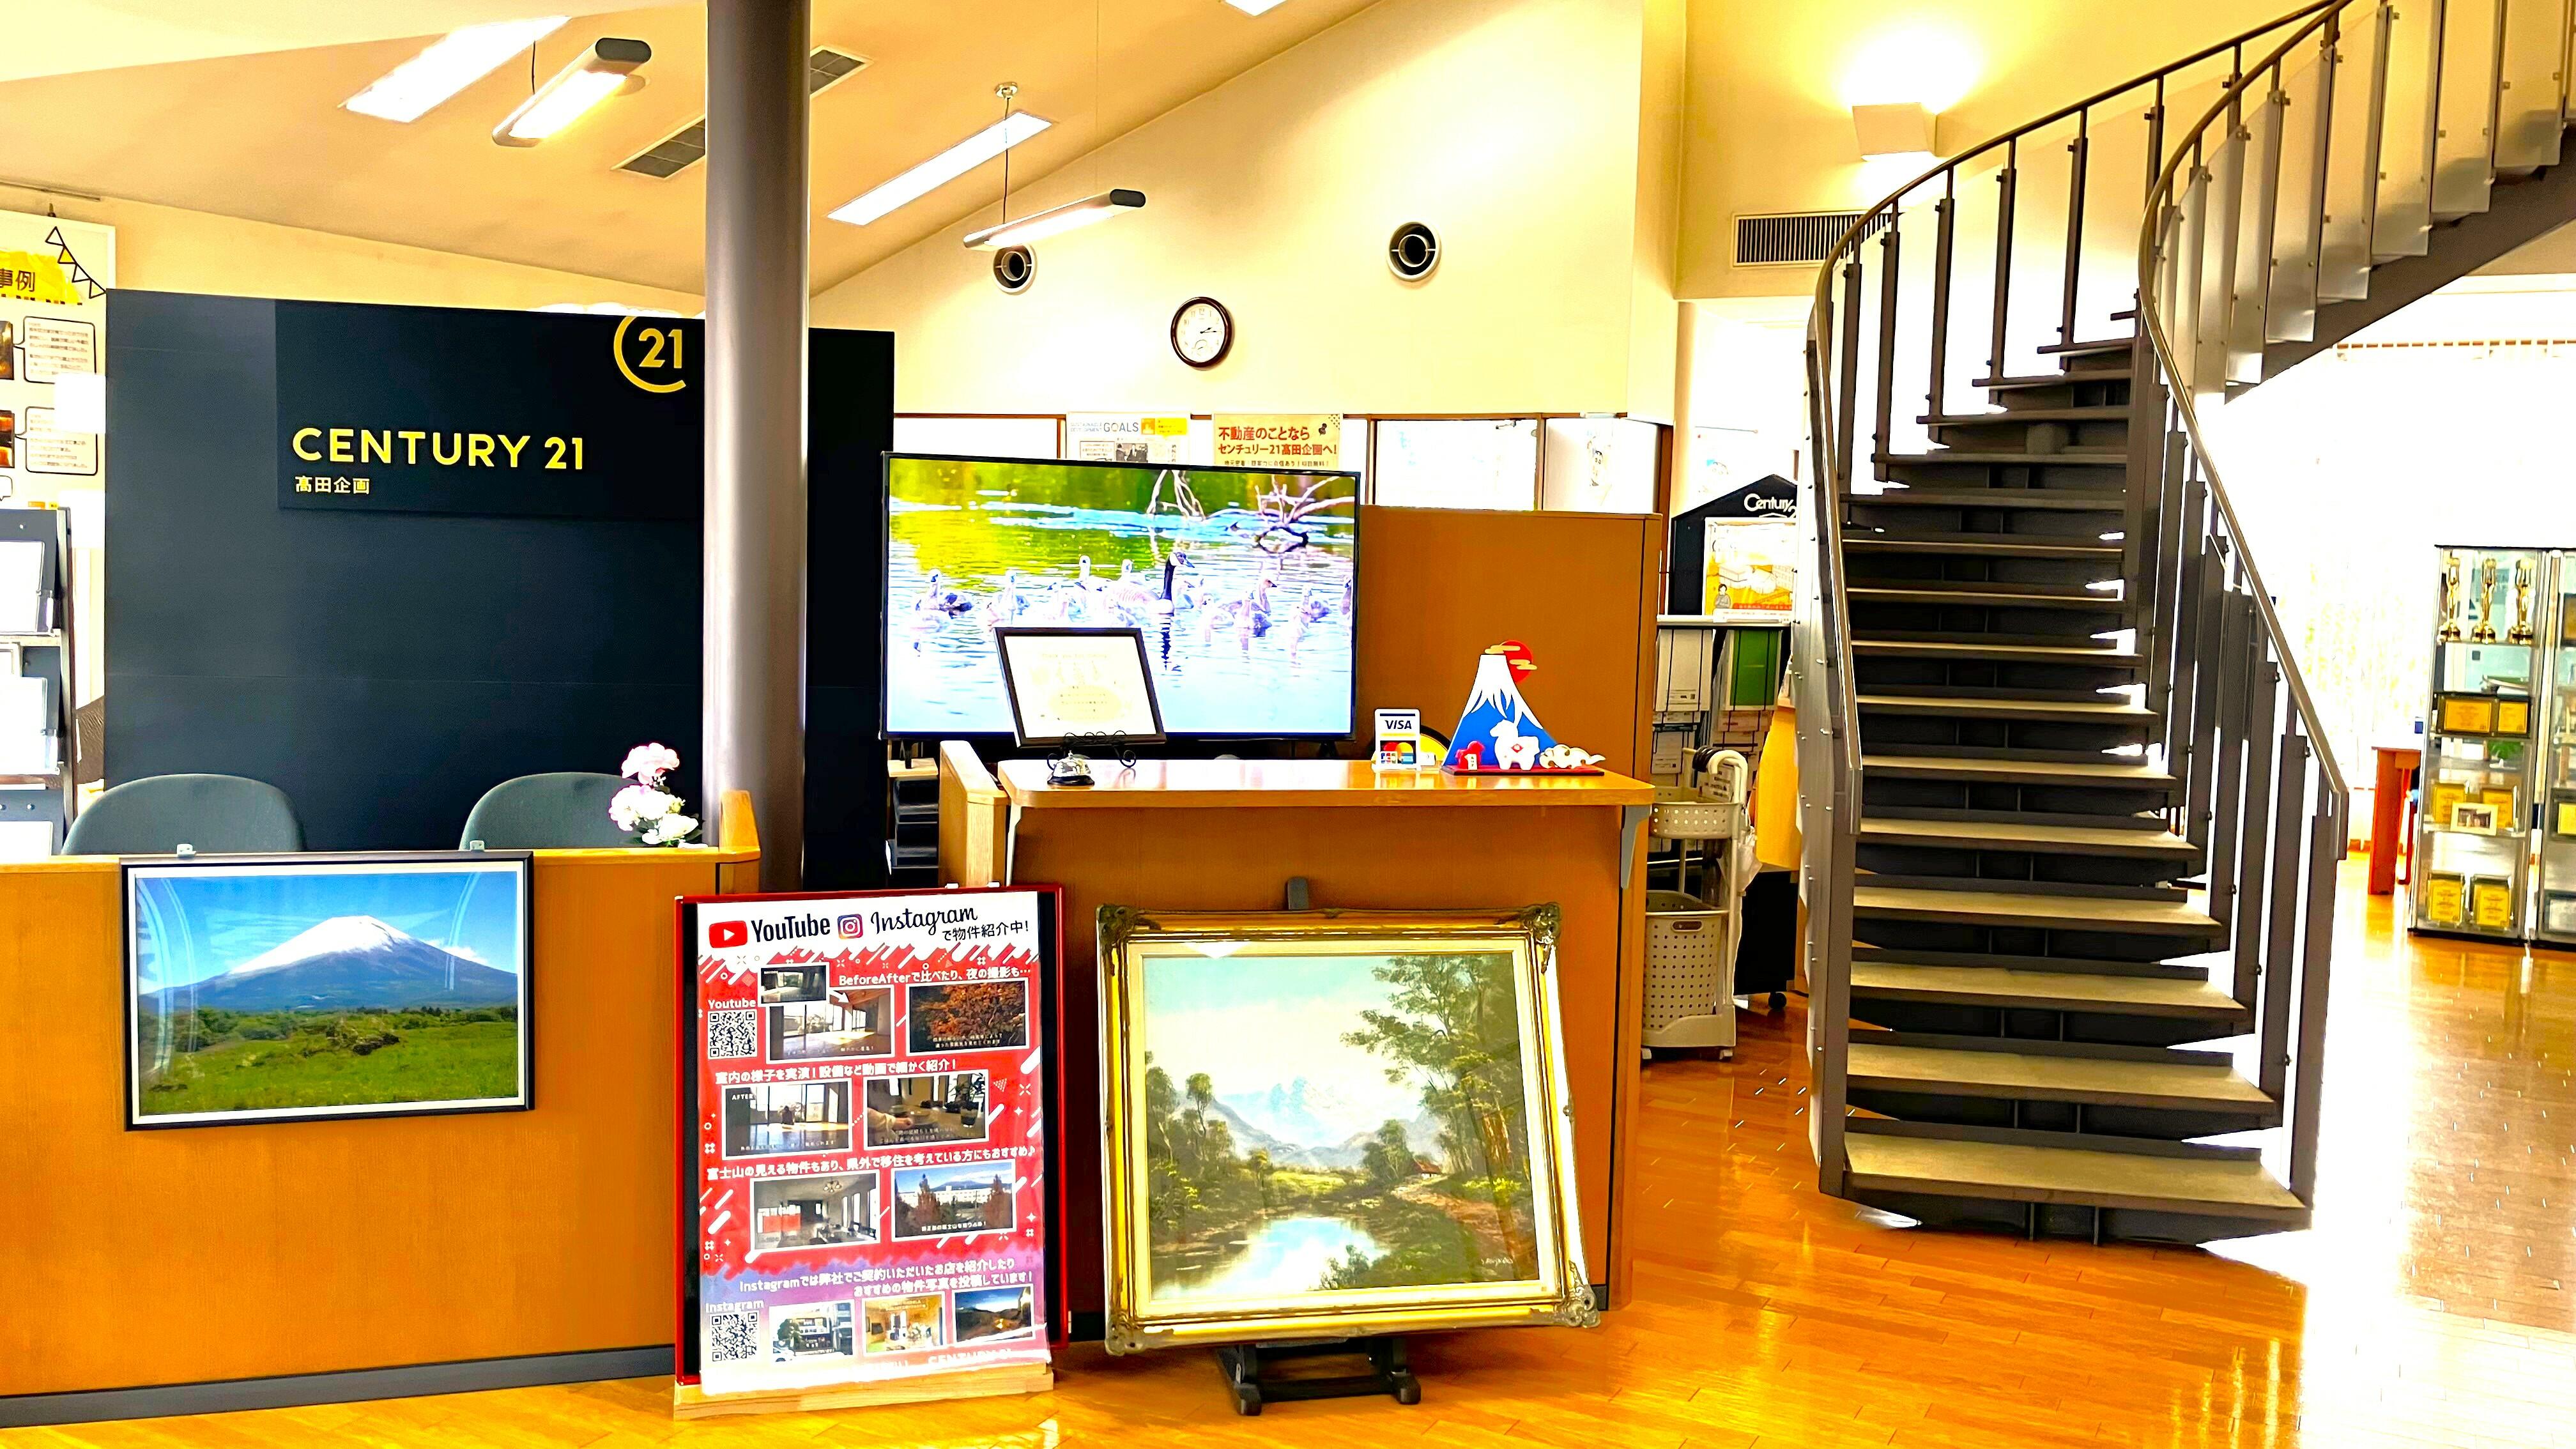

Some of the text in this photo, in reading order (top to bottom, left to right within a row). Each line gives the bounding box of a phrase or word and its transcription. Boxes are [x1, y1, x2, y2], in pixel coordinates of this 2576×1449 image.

[1103, 422, 1139, 433] GOALS
[1218, 425, 1310, 441] 不動産のことなら
[293, 427, 583, 470] CENTURY 21
[1744, 493, 1794, 512] Century
[1384, 719, 1412, 730] VISA
[751, 906, 977, 943] YouTube Instagram
[942, 920, 1029, 942] で物件紹介中!
[708, 998, 756, 1009] Youtube
[705, 1298, 765, 1314] Instagram
